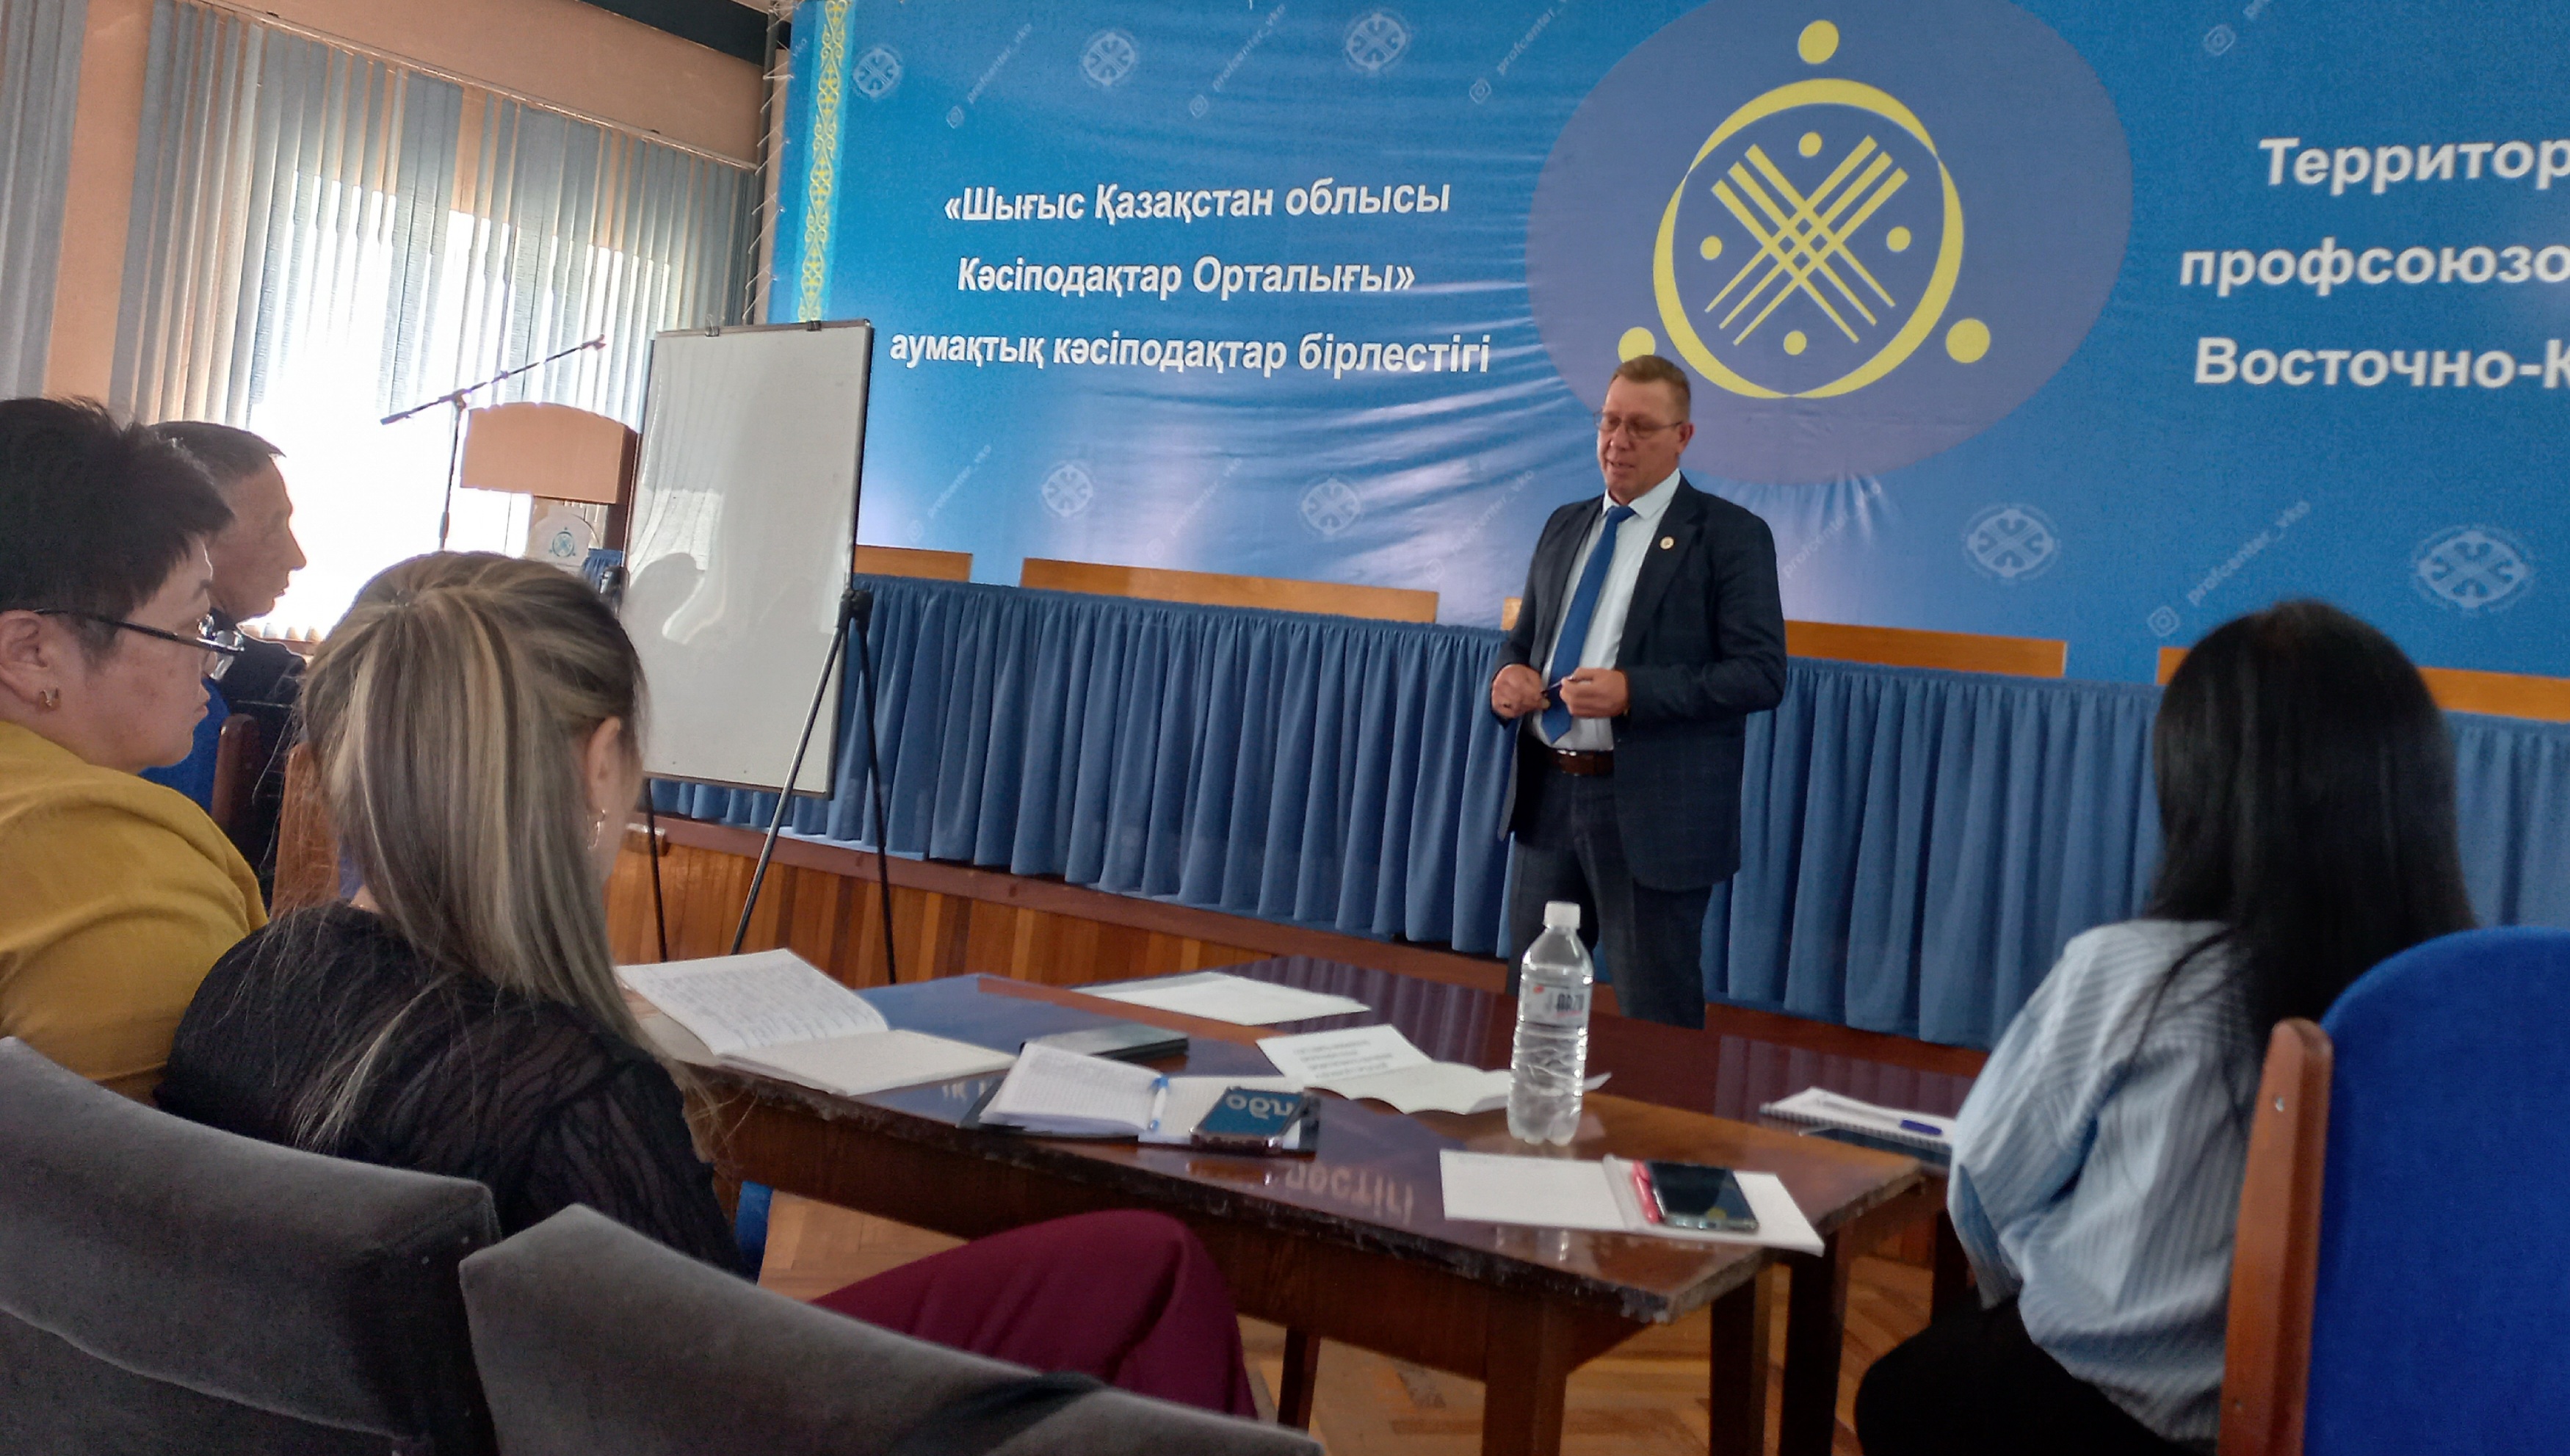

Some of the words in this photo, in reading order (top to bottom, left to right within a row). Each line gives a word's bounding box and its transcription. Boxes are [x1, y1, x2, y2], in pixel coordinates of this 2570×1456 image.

[2259, 137, 2570, 195] Территор
[944, 186, 1085, 221] «Шығыс
[1095, 184, 1274, 225] Қазақстан
[1285, 177, 1450, 216] облысы
[958, 257, 1182, 301] Кәсіподақтар
[1192, 256, 1416, 301] Орталығы»
[2181, 237, 2570, 297] профсоюзо
[889, 334, 1046, 369] аумақтық
[1053, 330, 1287, 378] кәсіподақтар
[1299, 332, 1490, 380] бірлестігі
